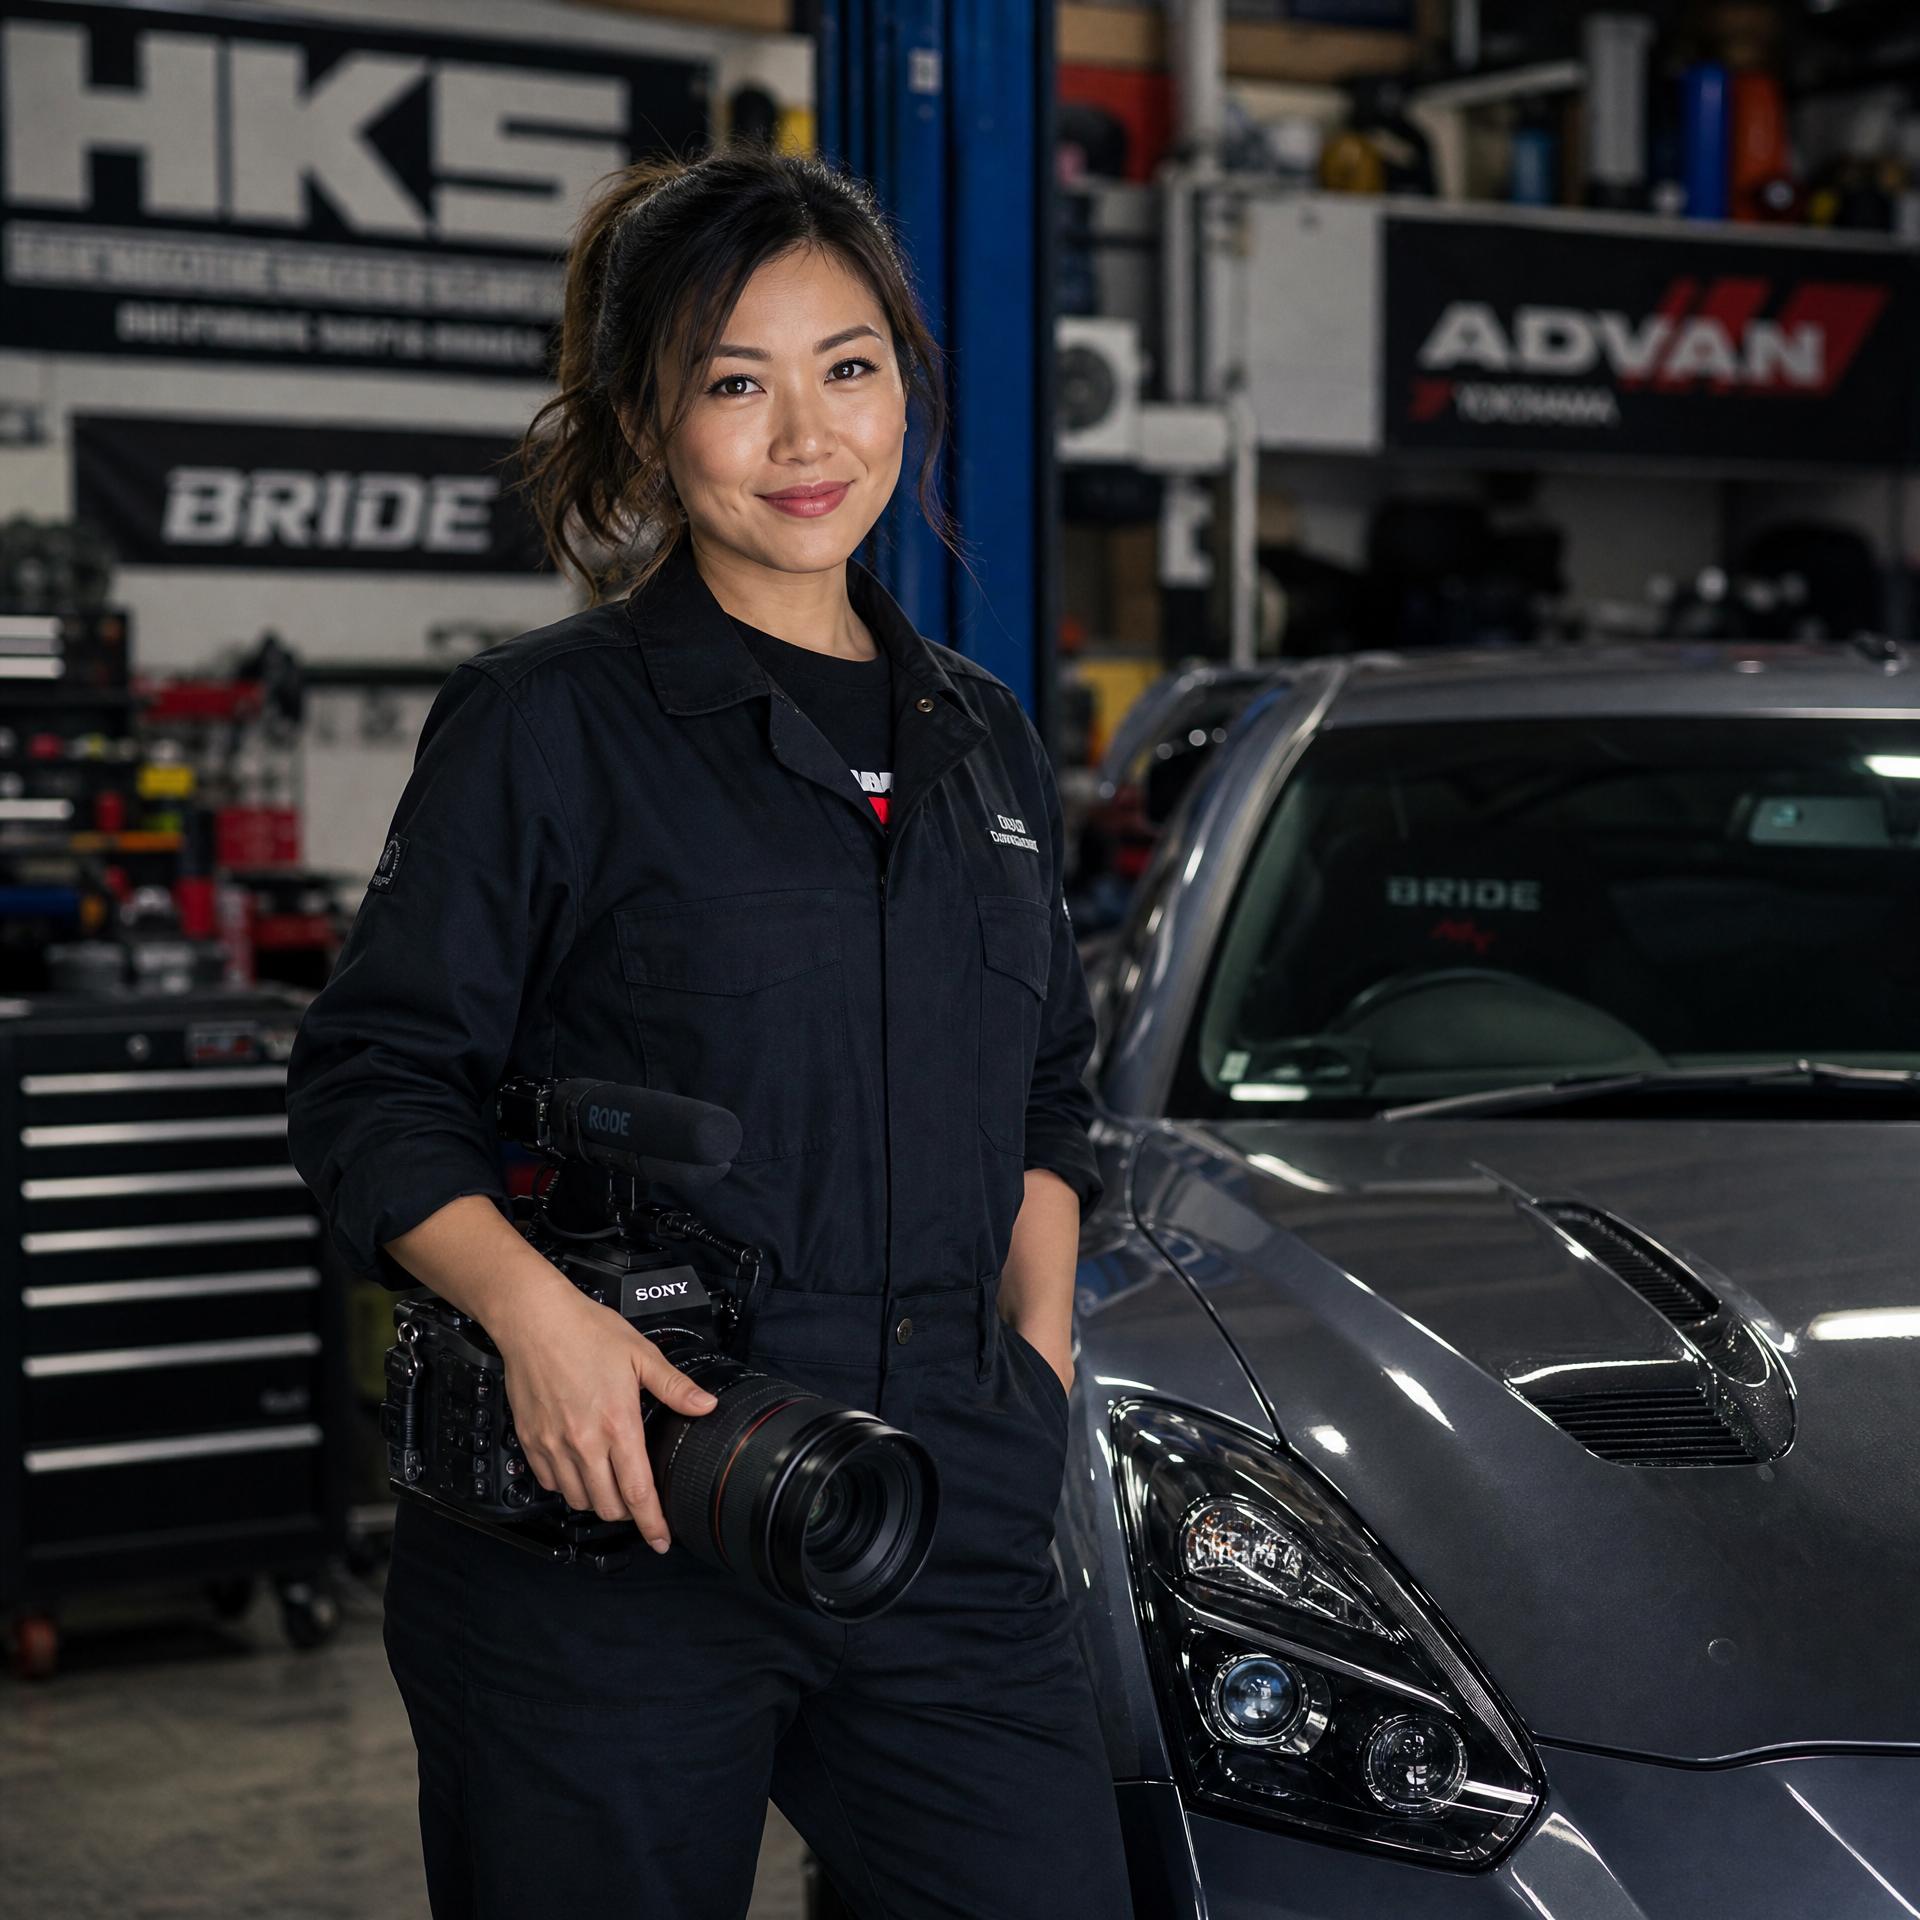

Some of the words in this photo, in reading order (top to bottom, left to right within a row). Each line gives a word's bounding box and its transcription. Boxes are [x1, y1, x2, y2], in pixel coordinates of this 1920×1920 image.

[5, 20, 628, 247] HKS
[1420, 301, 1823, 385] ADVAN
[164, 468, 497, 552] BRIDE
[1387, 877, 1541, 911] BRIDE
[588, 1104, 632, 1137] RODE
[635, 1281, 688, 1301] SONY
